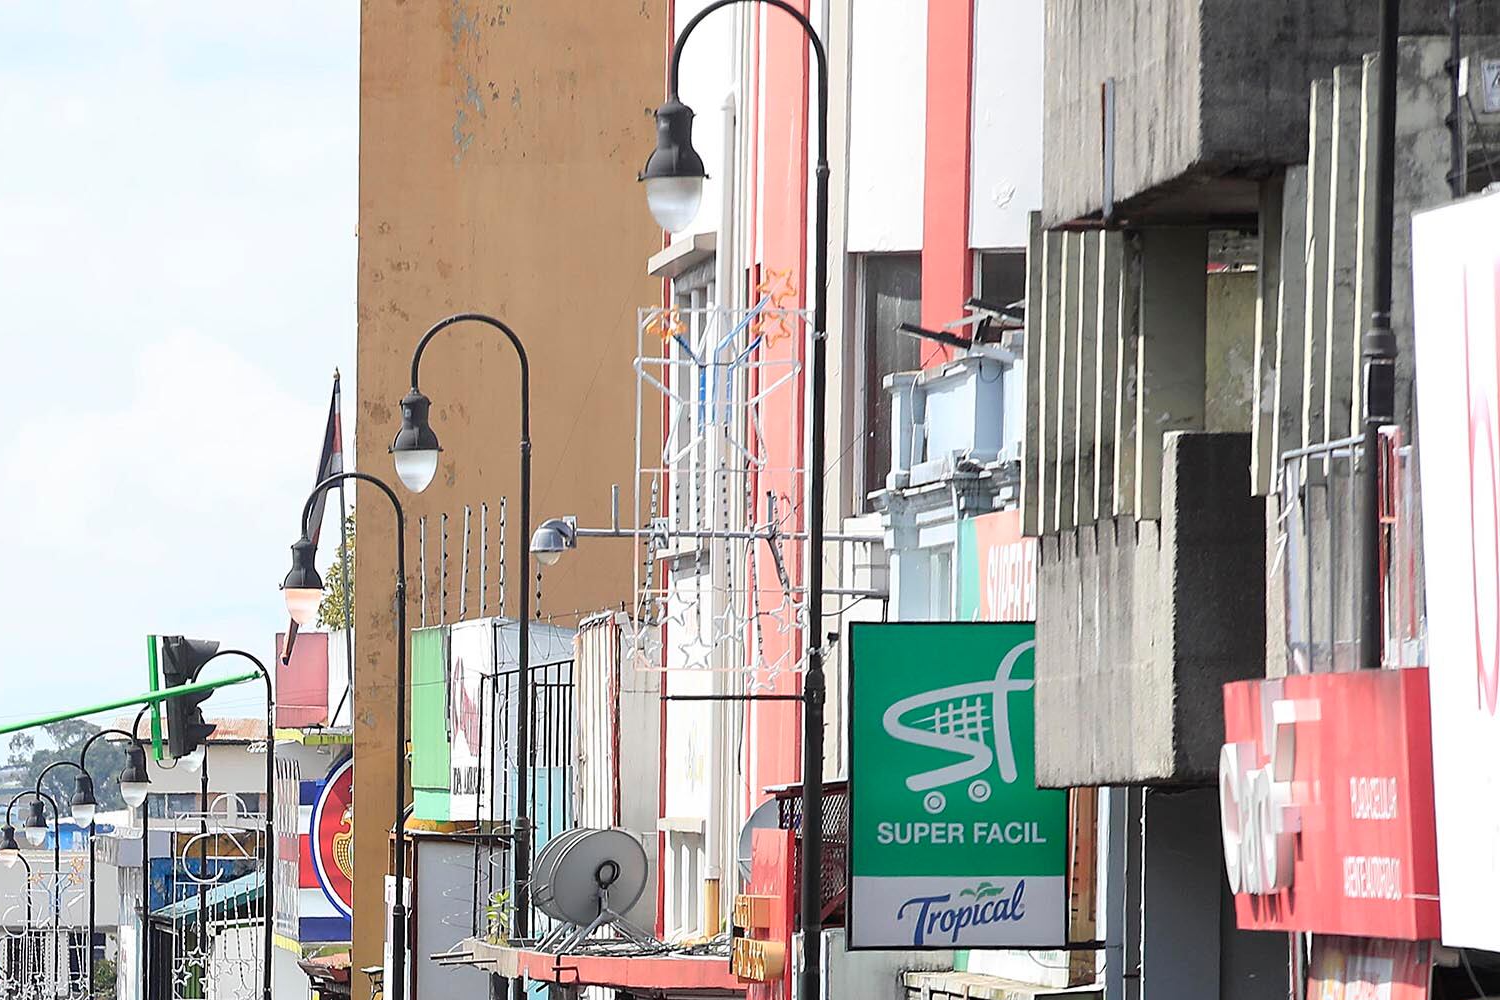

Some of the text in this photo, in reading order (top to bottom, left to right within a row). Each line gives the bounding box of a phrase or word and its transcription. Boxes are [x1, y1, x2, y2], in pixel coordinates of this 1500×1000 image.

[877, 822, 1046, 845] SUPER FACIL
[897, 879, 1022, 945] Tropical
